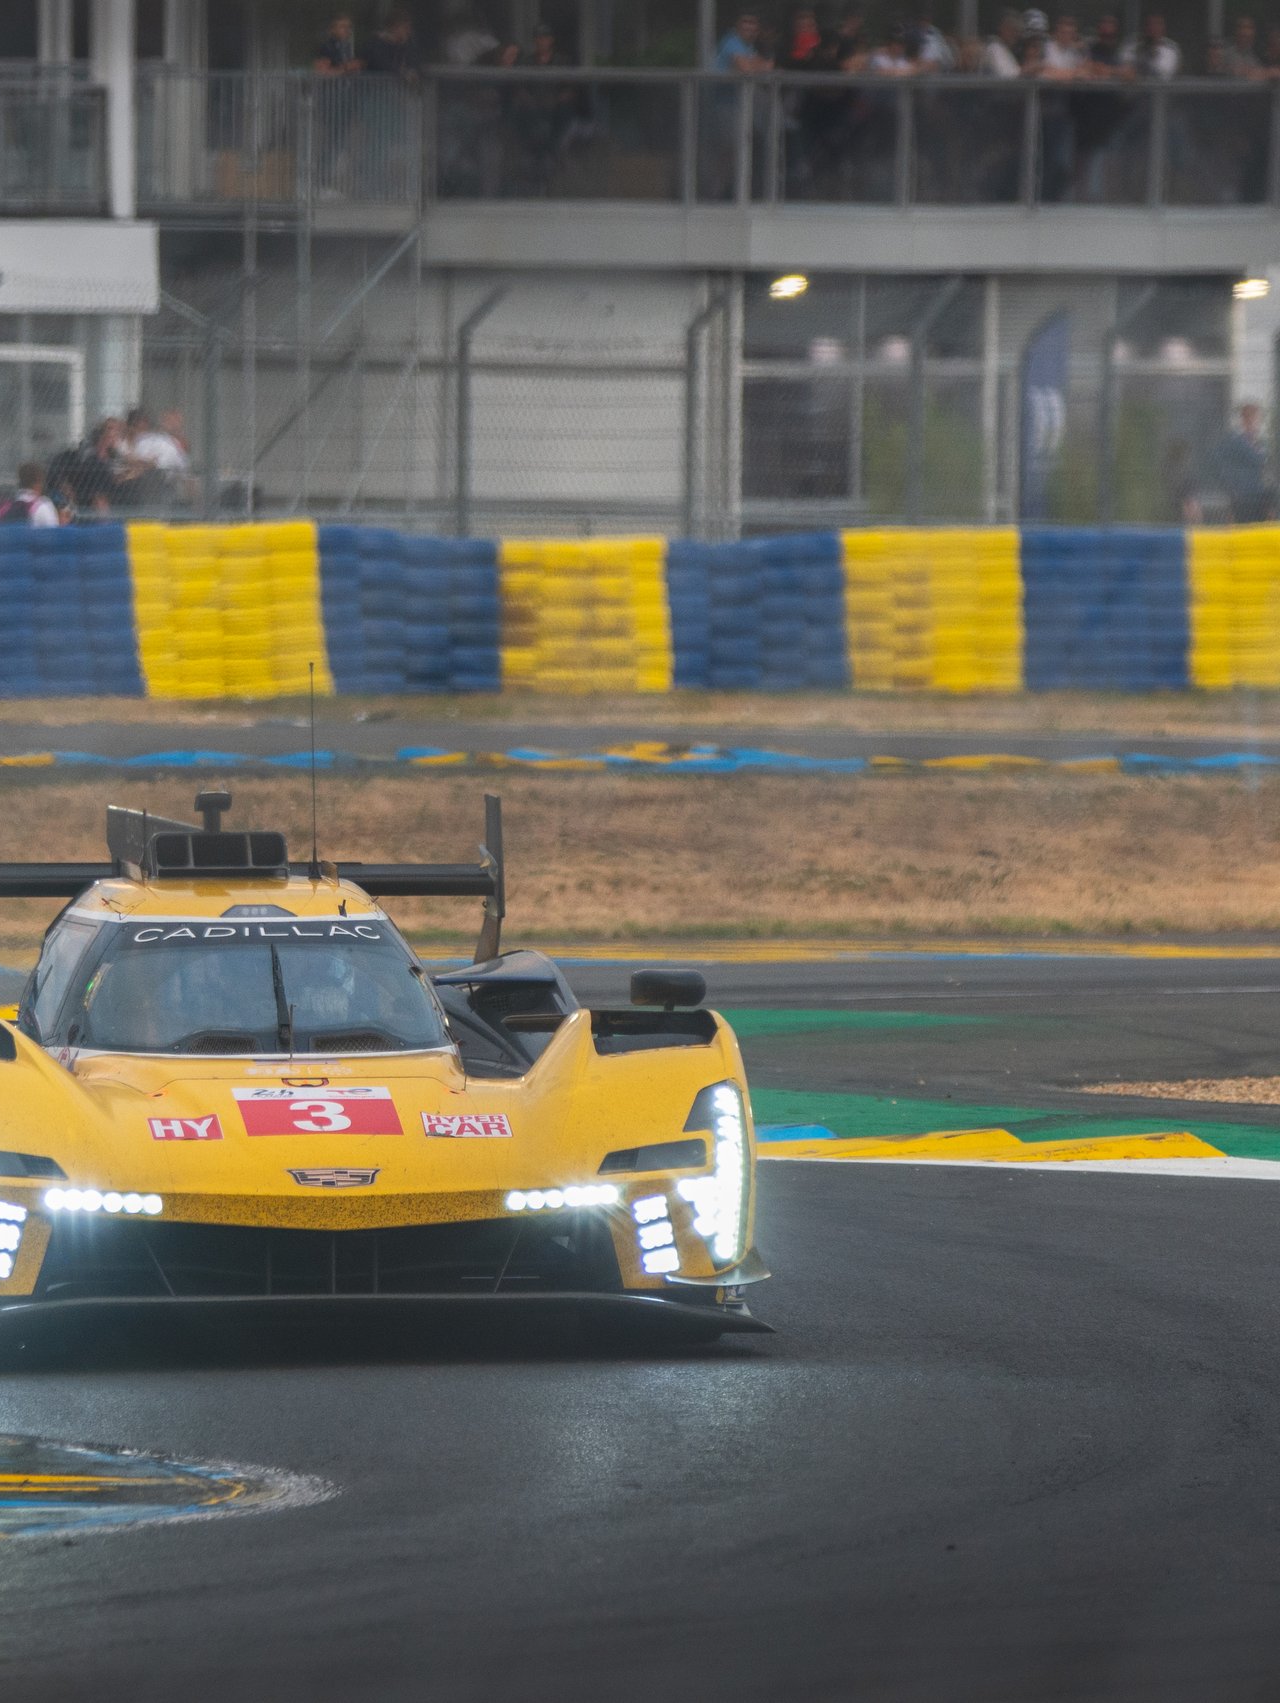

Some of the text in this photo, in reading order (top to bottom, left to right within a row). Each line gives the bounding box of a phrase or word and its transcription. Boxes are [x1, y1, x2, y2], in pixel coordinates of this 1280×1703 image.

[133, 925, 381, 943] CADILLAC
[289, 1100, 352, 1132] 3
[425, 1115, 505, 1124] HYPER
[151, 1117, 214, 1138] HY
[427, 1122, 509, 1136] CAR
